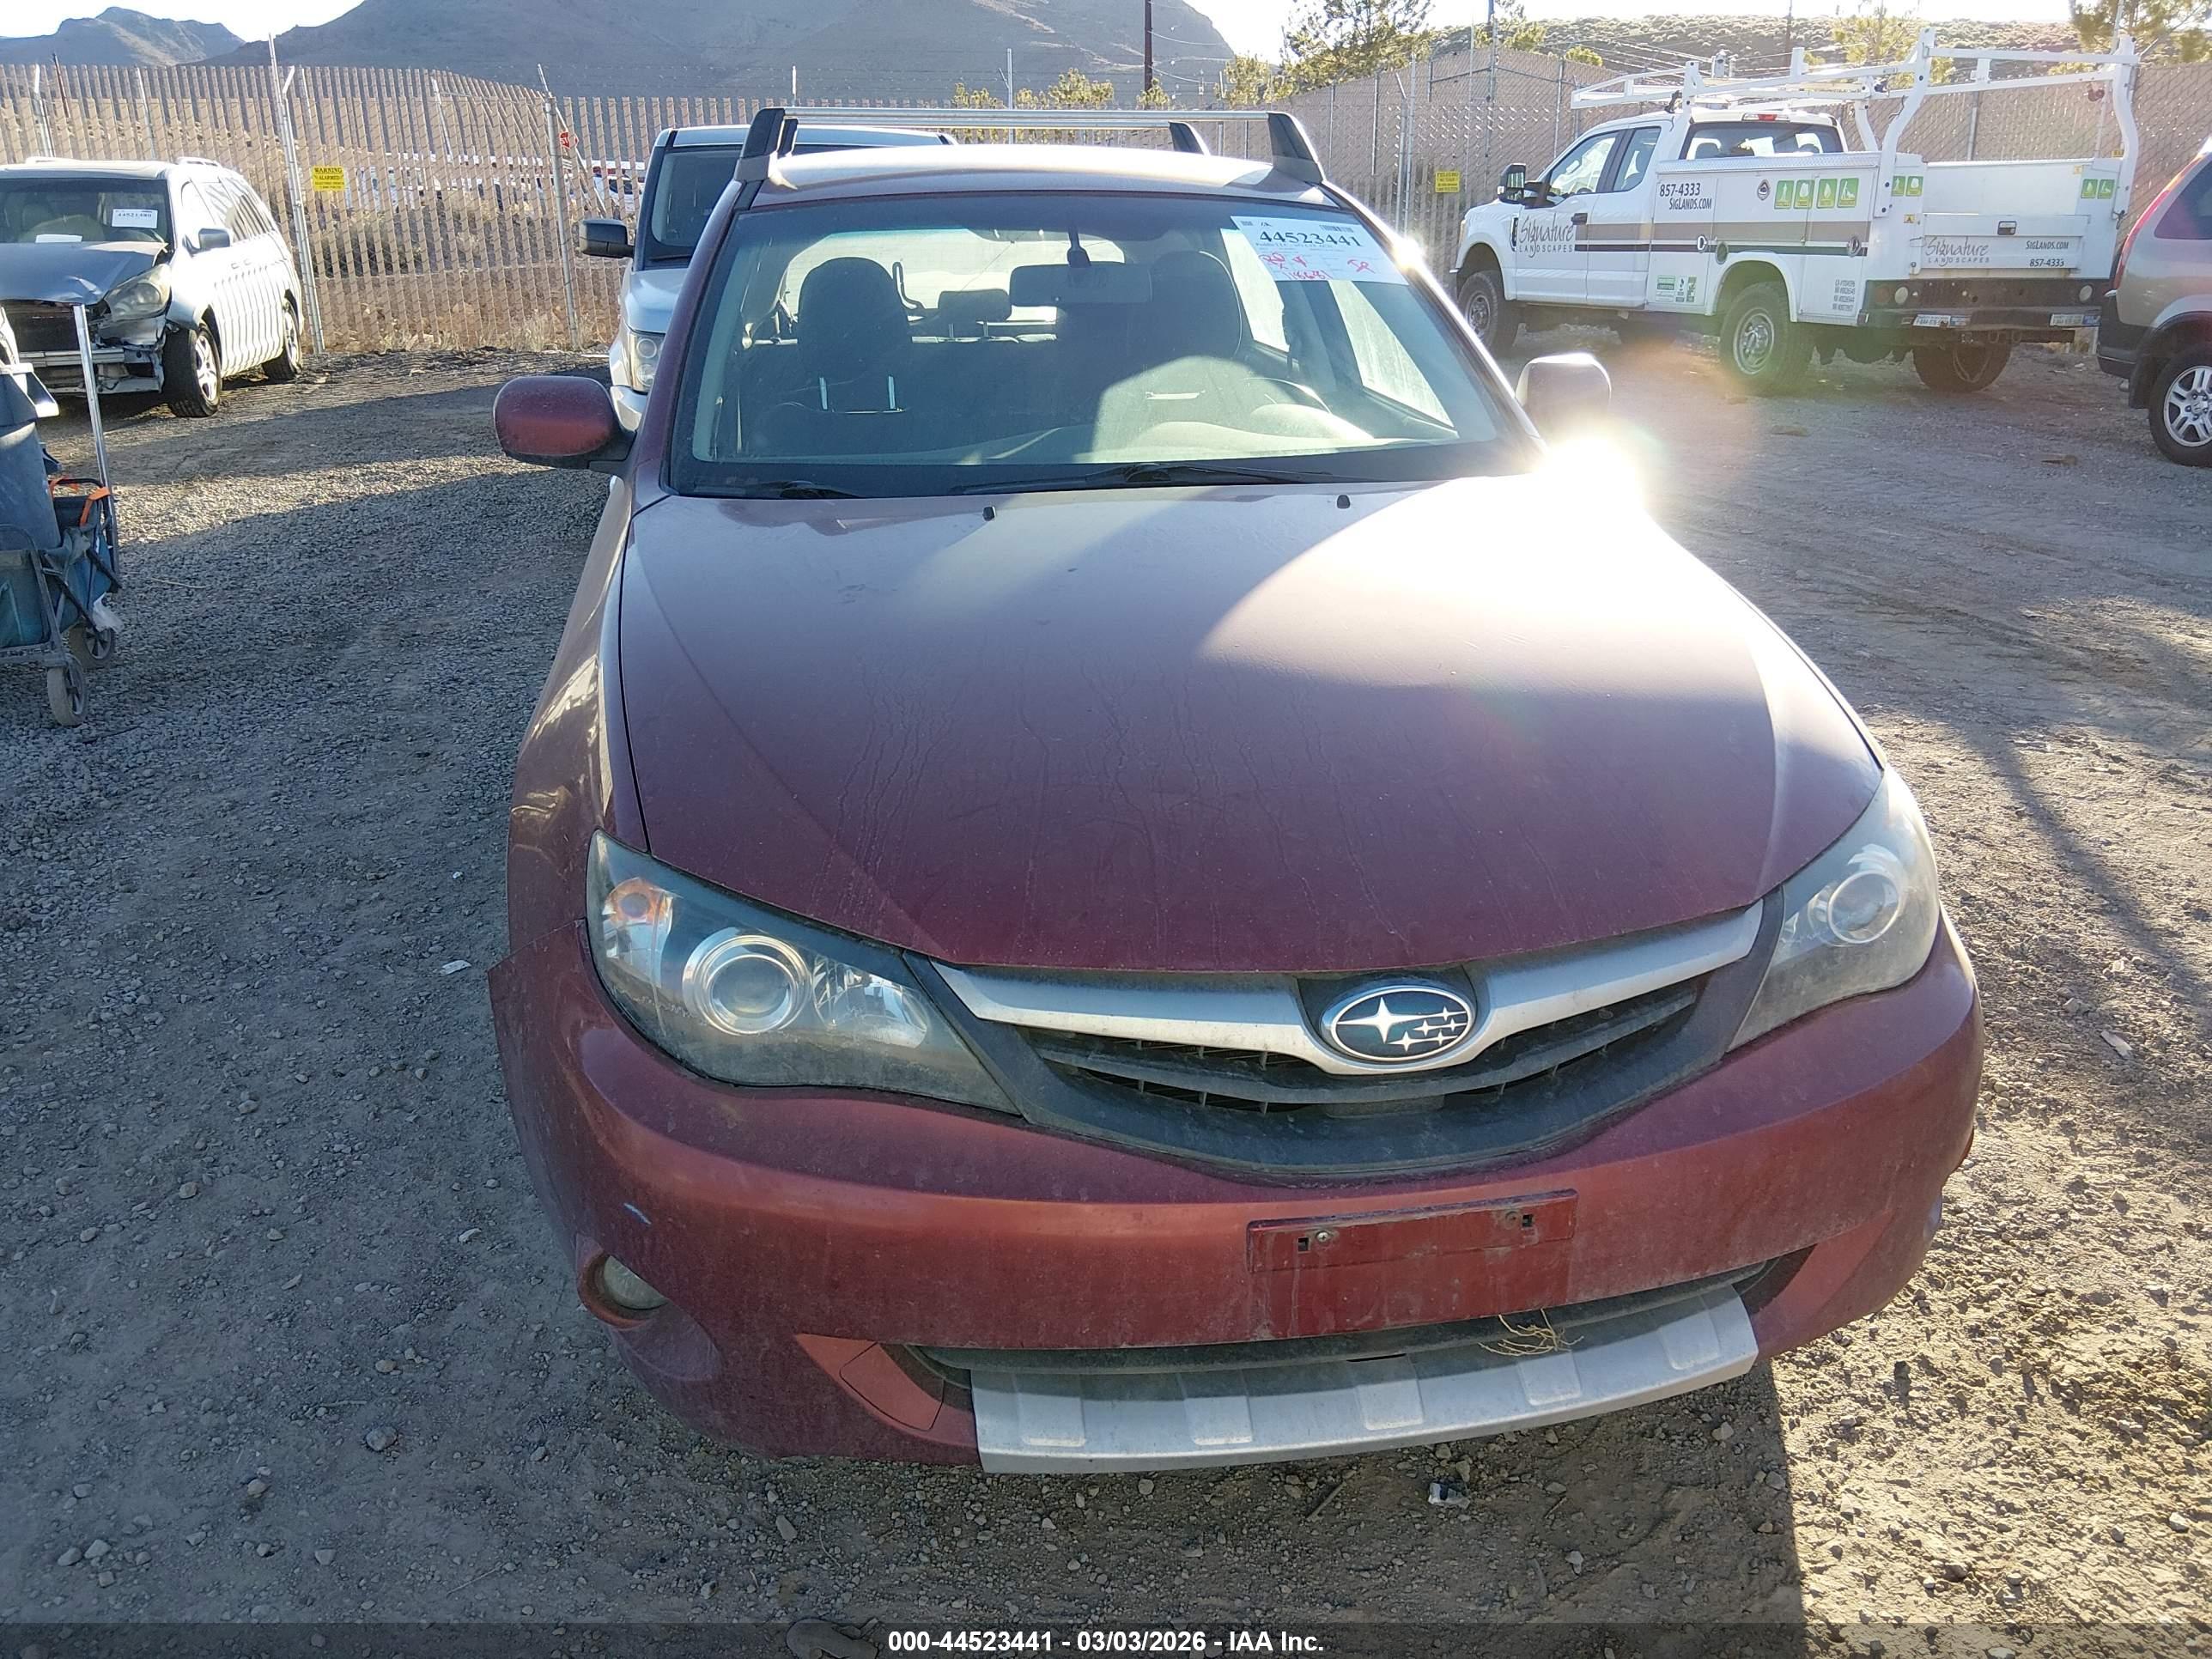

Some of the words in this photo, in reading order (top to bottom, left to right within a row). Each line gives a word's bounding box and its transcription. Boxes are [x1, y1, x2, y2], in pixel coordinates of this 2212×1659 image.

[1659, 182, 1701, 198] 857-4333
[1259, 230, 1361, 247] 44523441
[1518, 211, 1574, 258] Signature
[1519, 244, 1573, 253] LANDSCAPES
[1925, 235, 1990, 266] Signature
[2029, 258, 2065, 267] 857-4333
